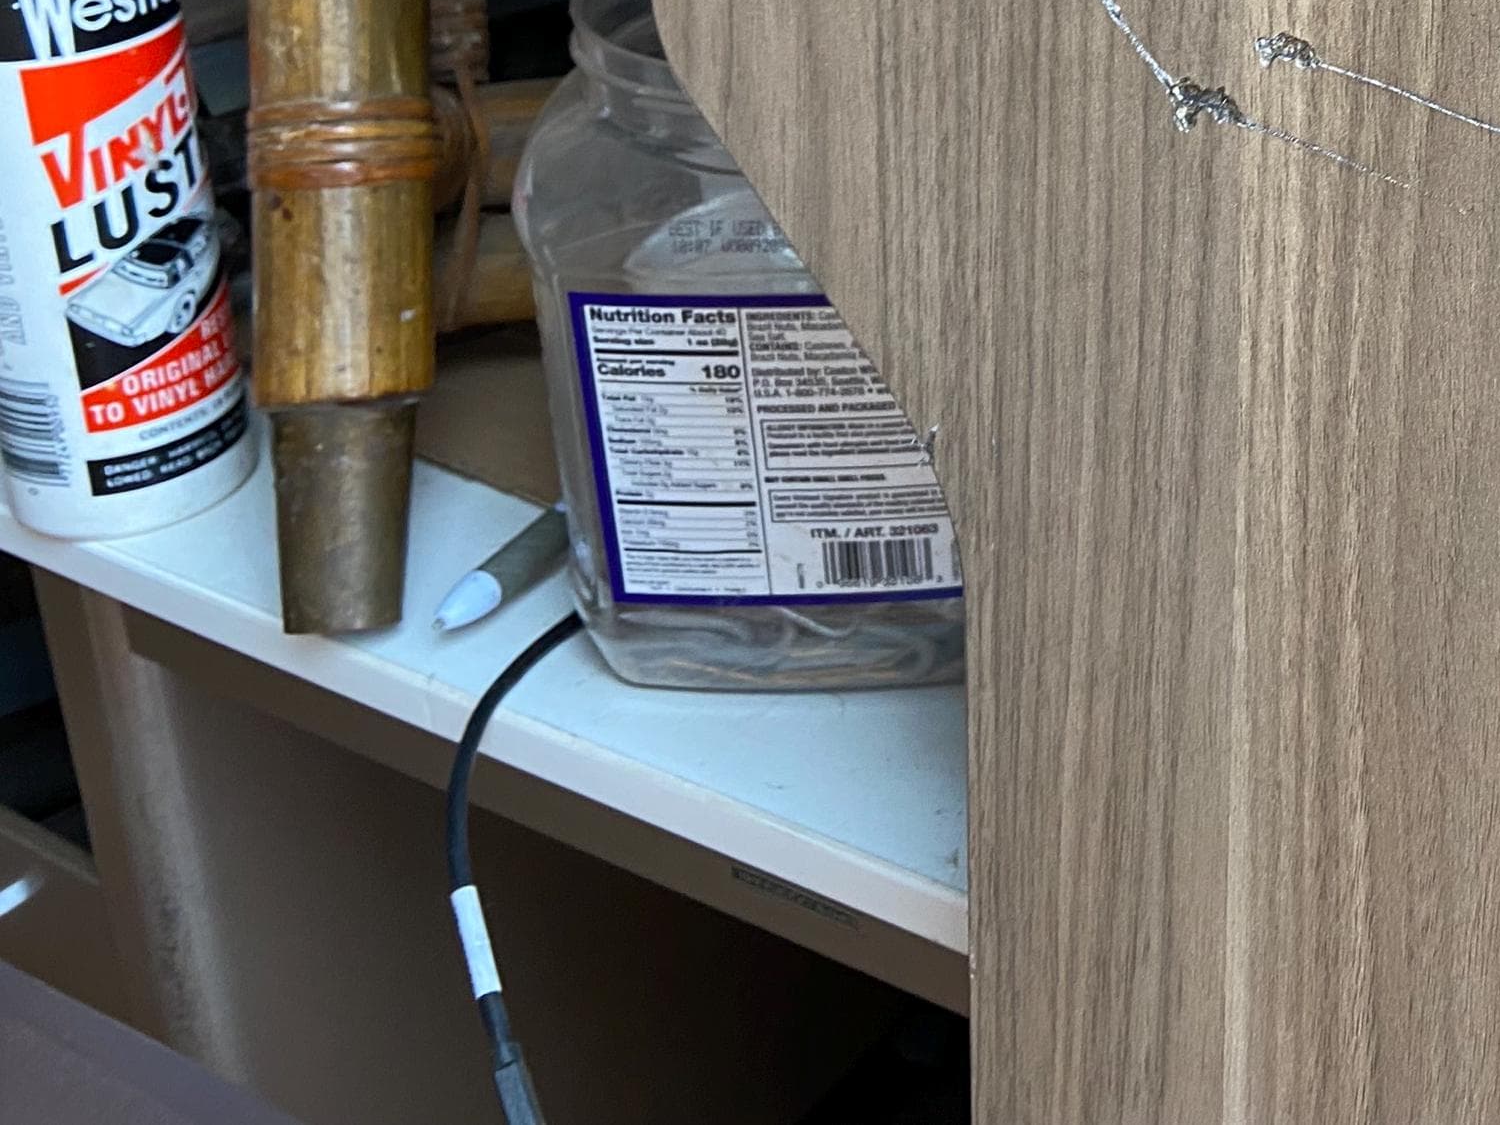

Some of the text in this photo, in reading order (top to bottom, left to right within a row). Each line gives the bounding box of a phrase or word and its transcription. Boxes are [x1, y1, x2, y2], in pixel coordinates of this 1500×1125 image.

[589, 308, 736, 323] Nutrition Facts
[597, 363, 741, 379] Calories 180
[89, 402, 126, 425] TO
[131, 378, 201, 417] VINYL
[810, 528, 841, 538] ITM.
[854, 526, 885, 538] ART.
